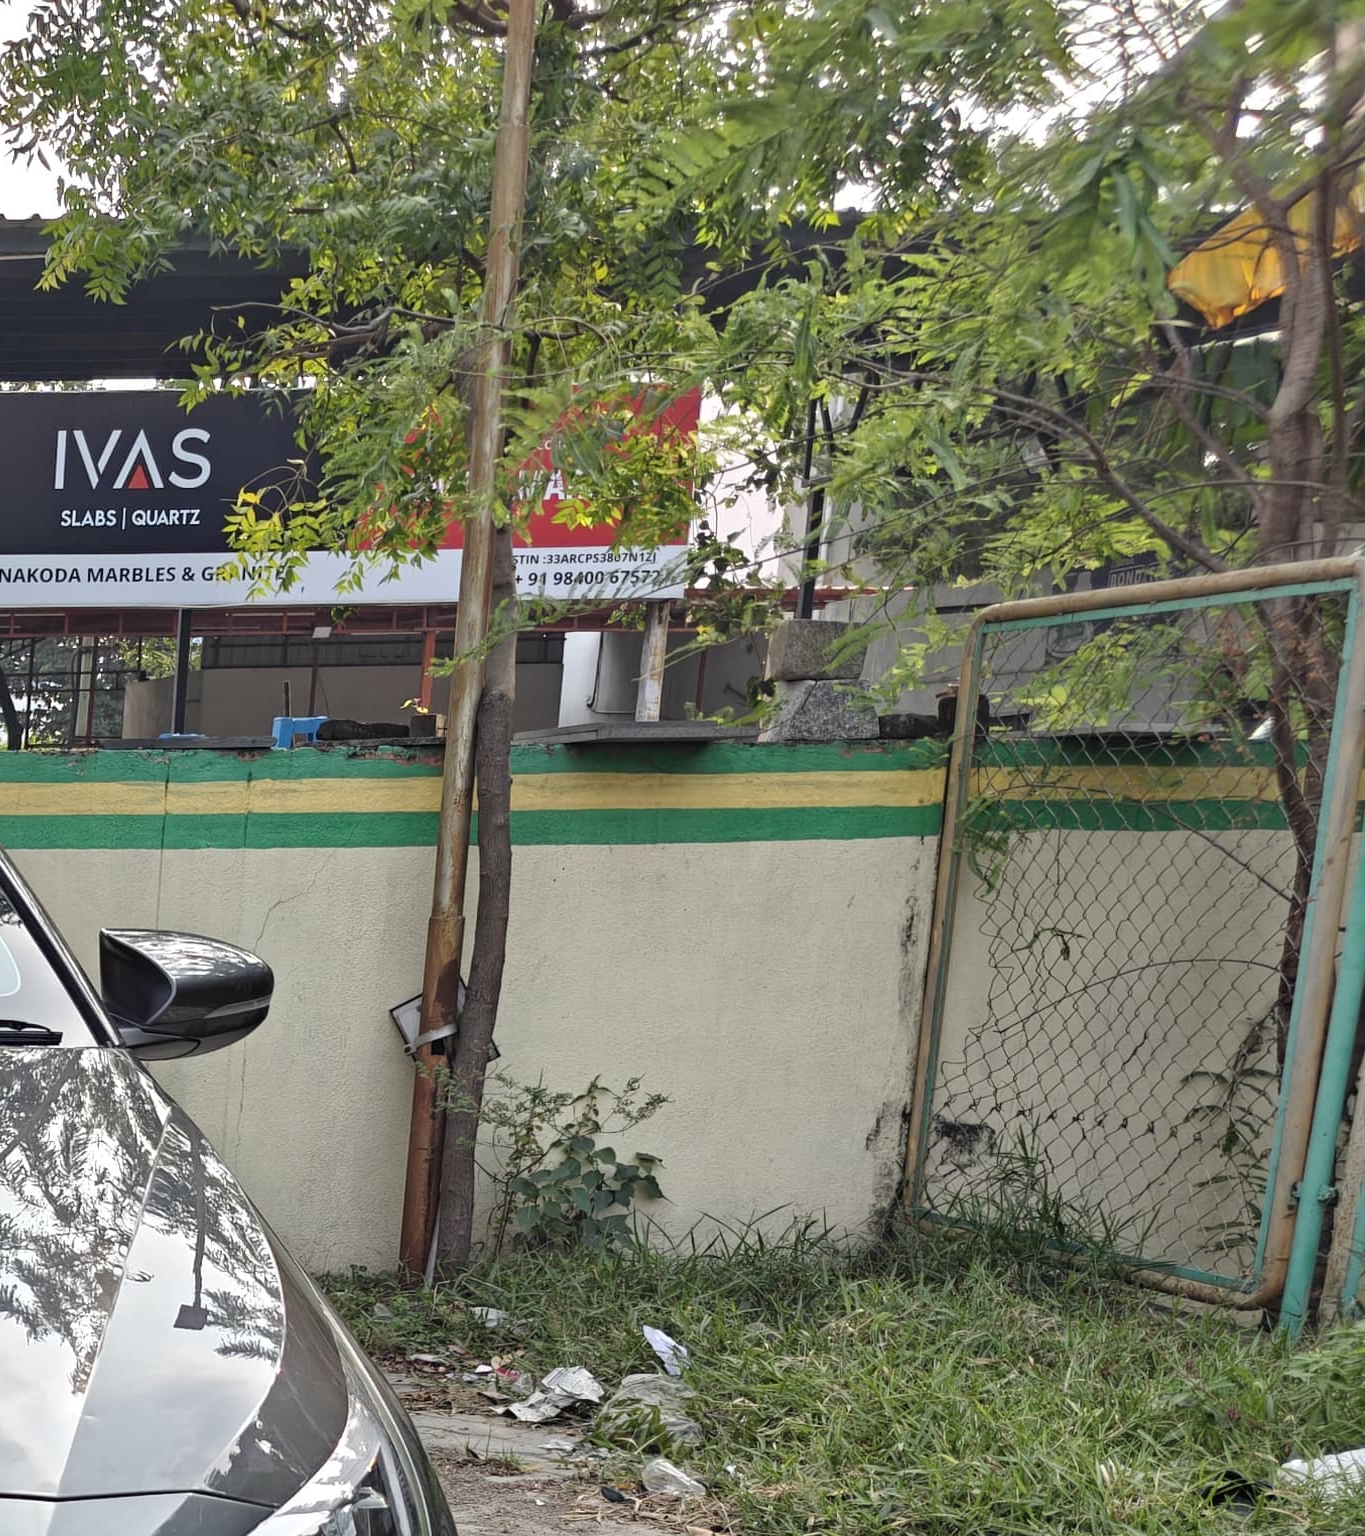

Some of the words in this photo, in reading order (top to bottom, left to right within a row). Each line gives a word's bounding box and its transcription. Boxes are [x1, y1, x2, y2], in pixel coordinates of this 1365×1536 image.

[54, 428, 212, 489] IVAS
[60, 509, 117, 527] SLABS
[131, 509, 200, 526] QUARTZ
[87, 566, 176, 583] MARBLES
[182, 566, 195, 582] &
